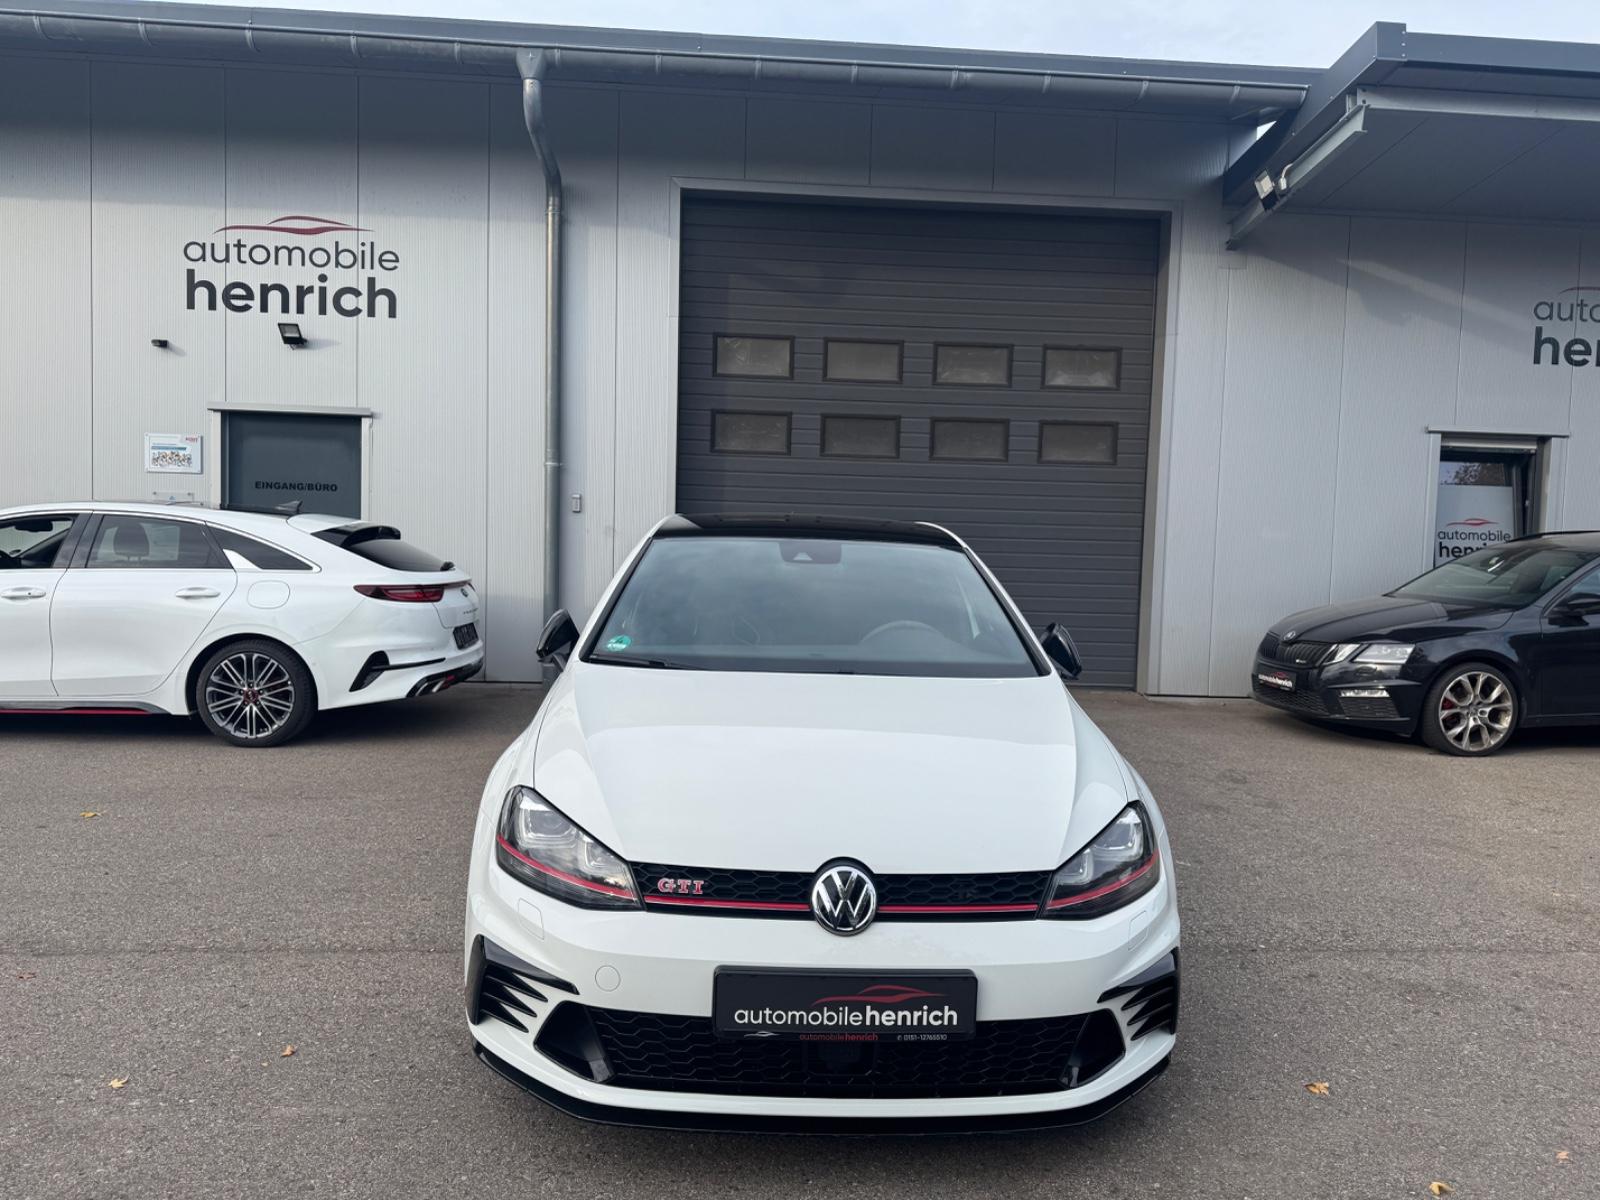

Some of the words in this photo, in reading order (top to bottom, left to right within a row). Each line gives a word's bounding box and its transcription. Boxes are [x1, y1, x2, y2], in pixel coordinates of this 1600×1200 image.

[183, 238, 400, 271] automobile
[186, 268, 397, 319] henrich
[1533, 325, 1600, 367] he
[255, 480, 338, 492] EINGANG/BÜRO
[1437, 530, 1511, 543] automobile
[657, 878, 705, 895] GTI
